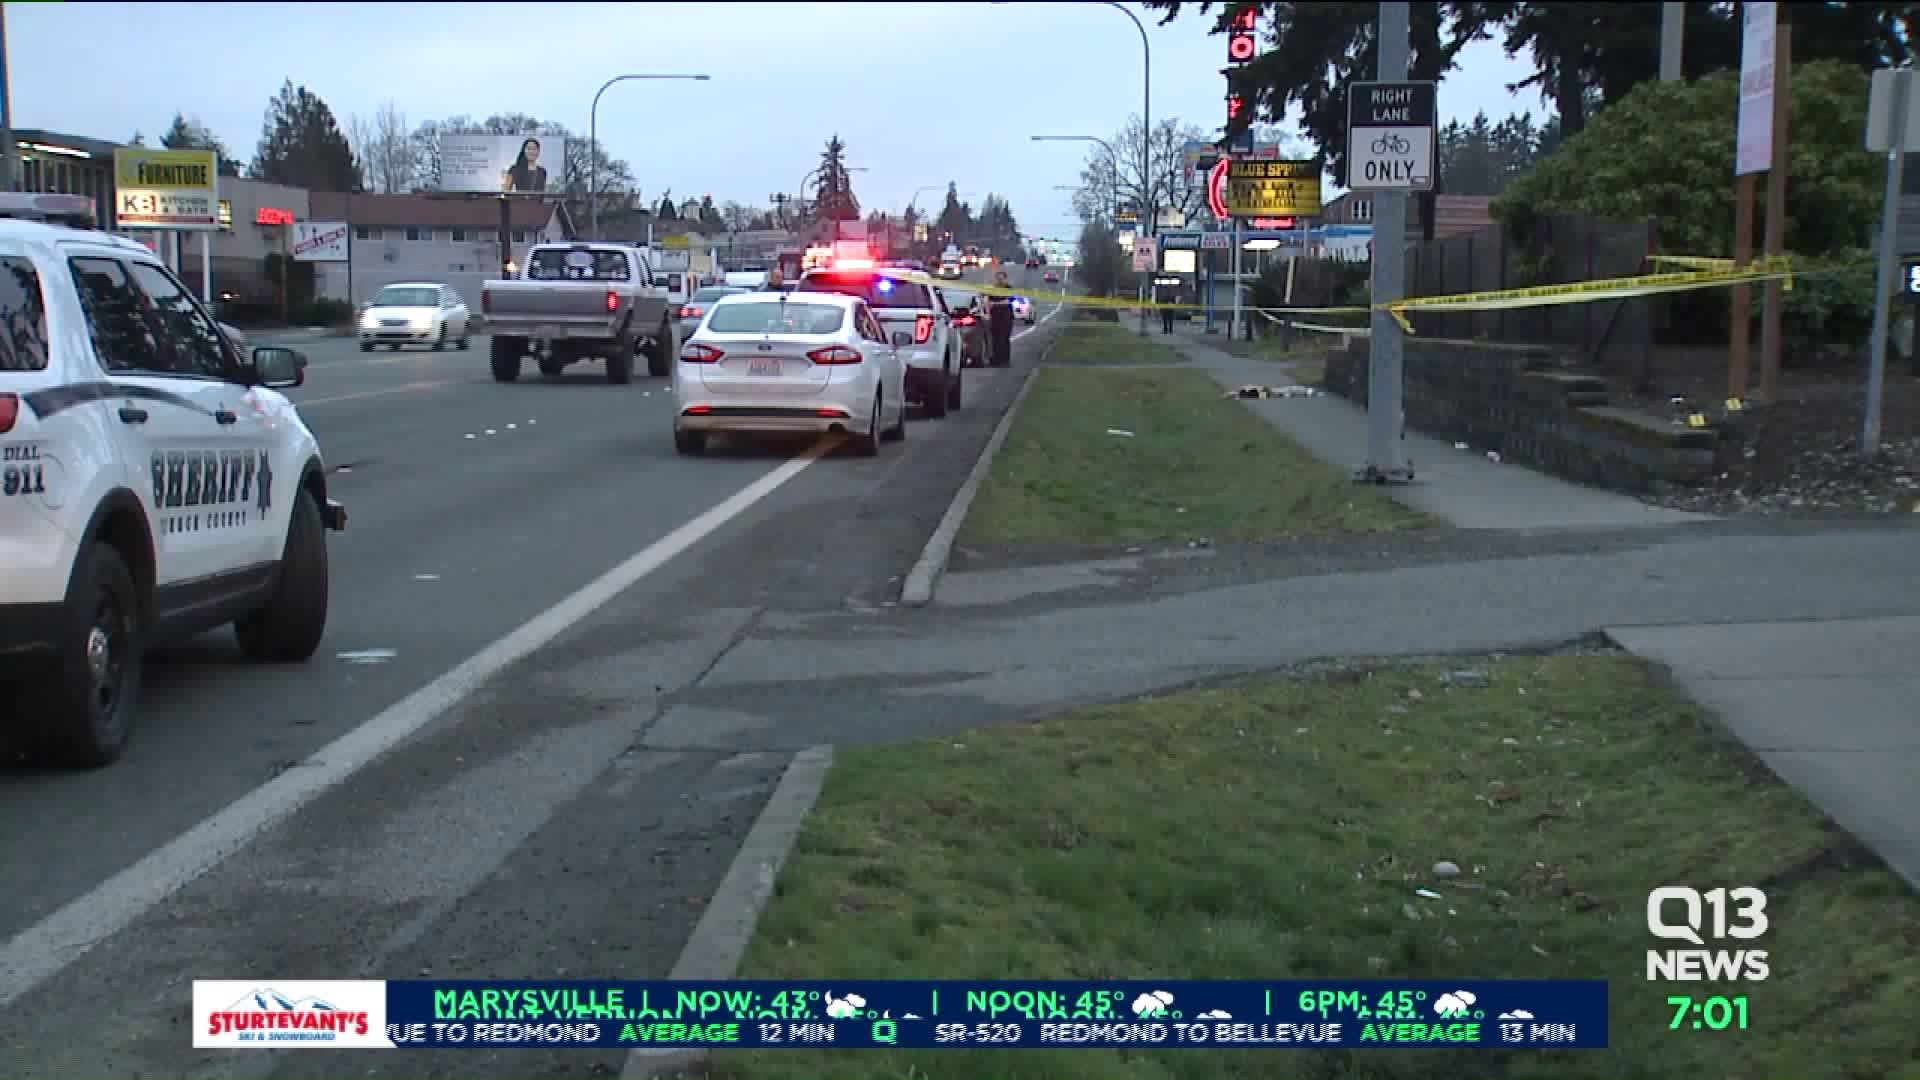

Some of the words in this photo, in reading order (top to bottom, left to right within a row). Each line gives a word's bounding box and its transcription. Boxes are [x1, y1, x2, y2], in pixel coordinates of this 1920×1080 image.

[1371, 88, 1412, 104] RIGHT
[1373, 107, 1410, 120] LANE
[138, 163, 207, 185] FURNITURE
[1365, 159, 1415, 182] ONLY
[4, 446, 41, 461] DIAL
[3, 465, 46, 496] 911
[152, 450, 255, 508] SHERIFF
